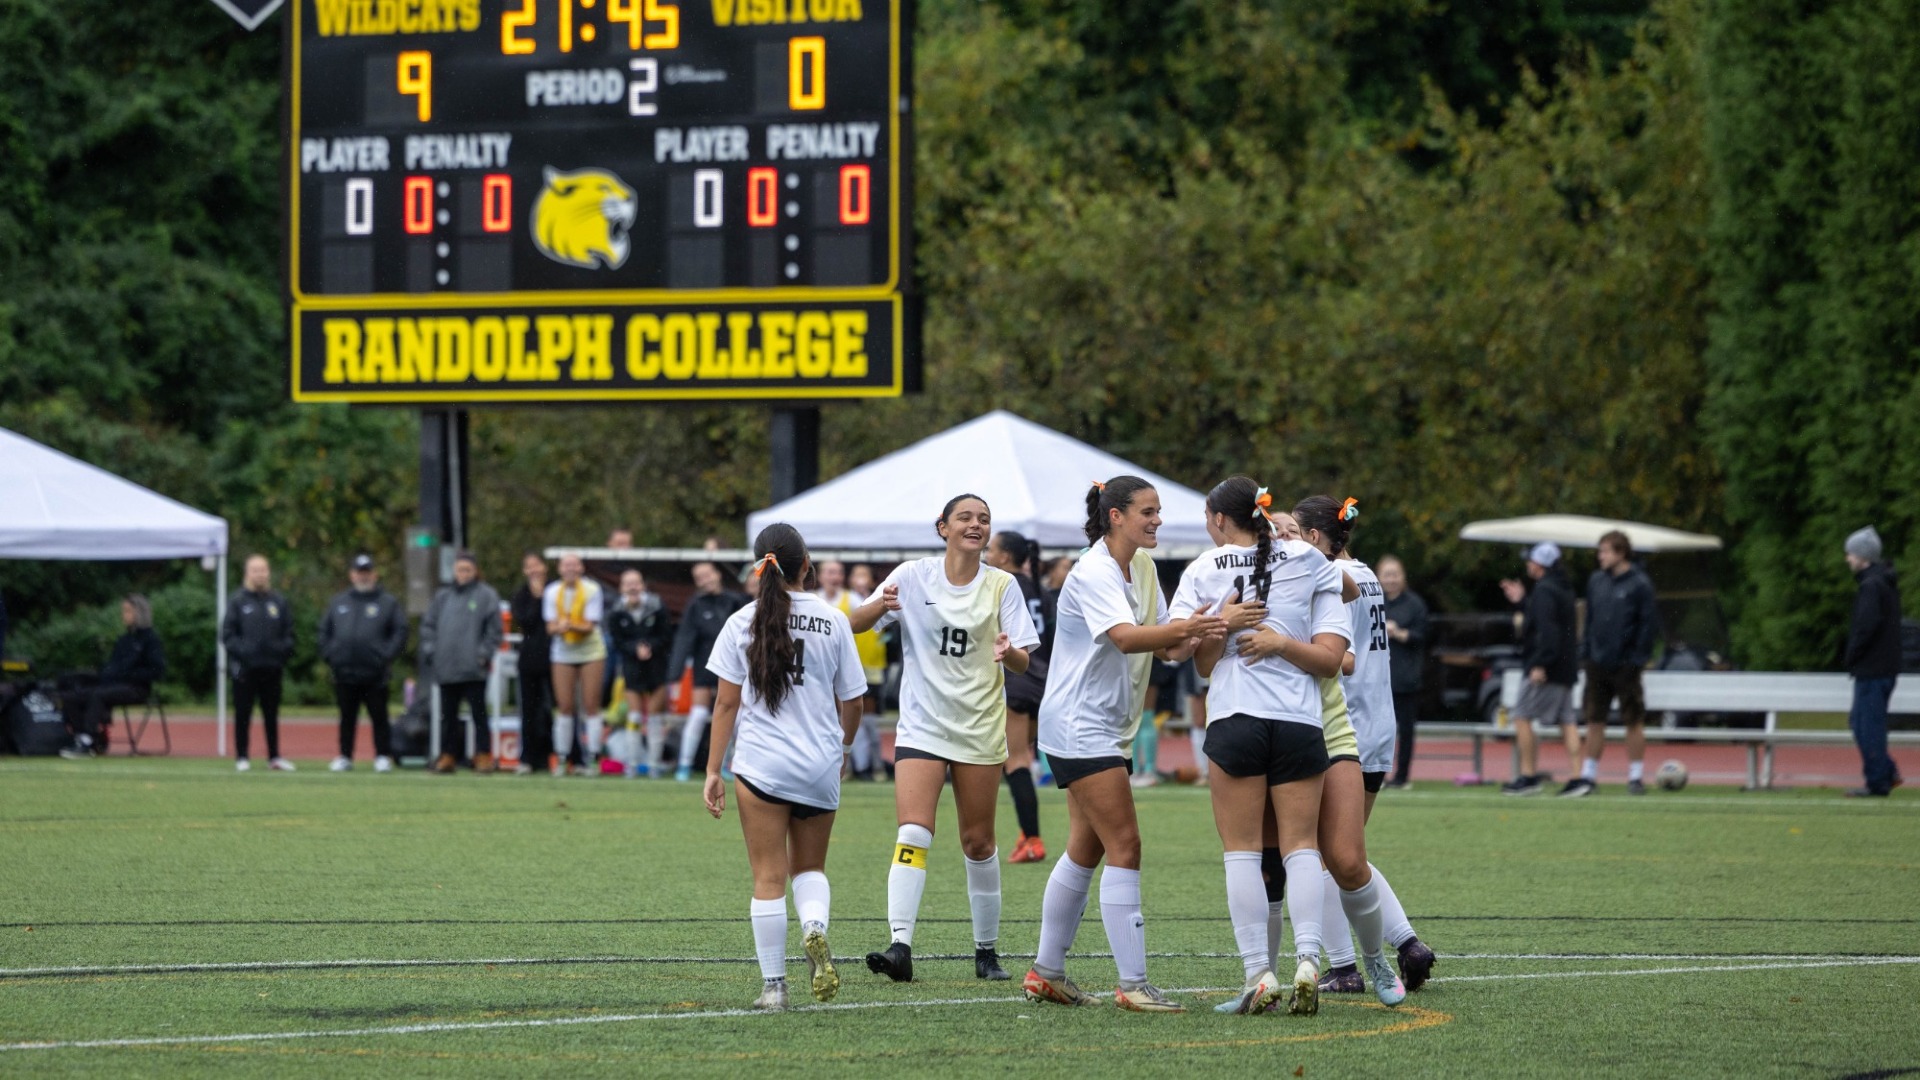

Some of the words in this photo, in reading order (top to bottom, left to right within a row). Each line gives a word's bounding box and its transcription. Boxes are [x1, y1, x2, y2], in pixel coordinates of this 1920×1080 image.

[315, 0, 482, 37] WILDCATS
[711, 0, 863, 27] VISITOR
[397, 50, 432, 122] 9
[526, 68, 625, 106] PERIOD
[629, 57, 658, 116] 2
[788, 36, 826, 110] 0
[301, 136, 390, 173] PLAYER
[404, 132, 512, 170] PENALTY
[654, 125, 749, 163] PLAYER
[766, 122, 880, 160] PENALTY
[345, 177, 373, 235] 0
[693, 168, 723, 228] 0
[322, 314, 614, 383] RANDOLPH
[625, 310, 868, 380] COLLEGE
[940, 626, 968, 658] 19
[1369, 604, 1387, 651] 25
[898, 848, 914, 864] C
